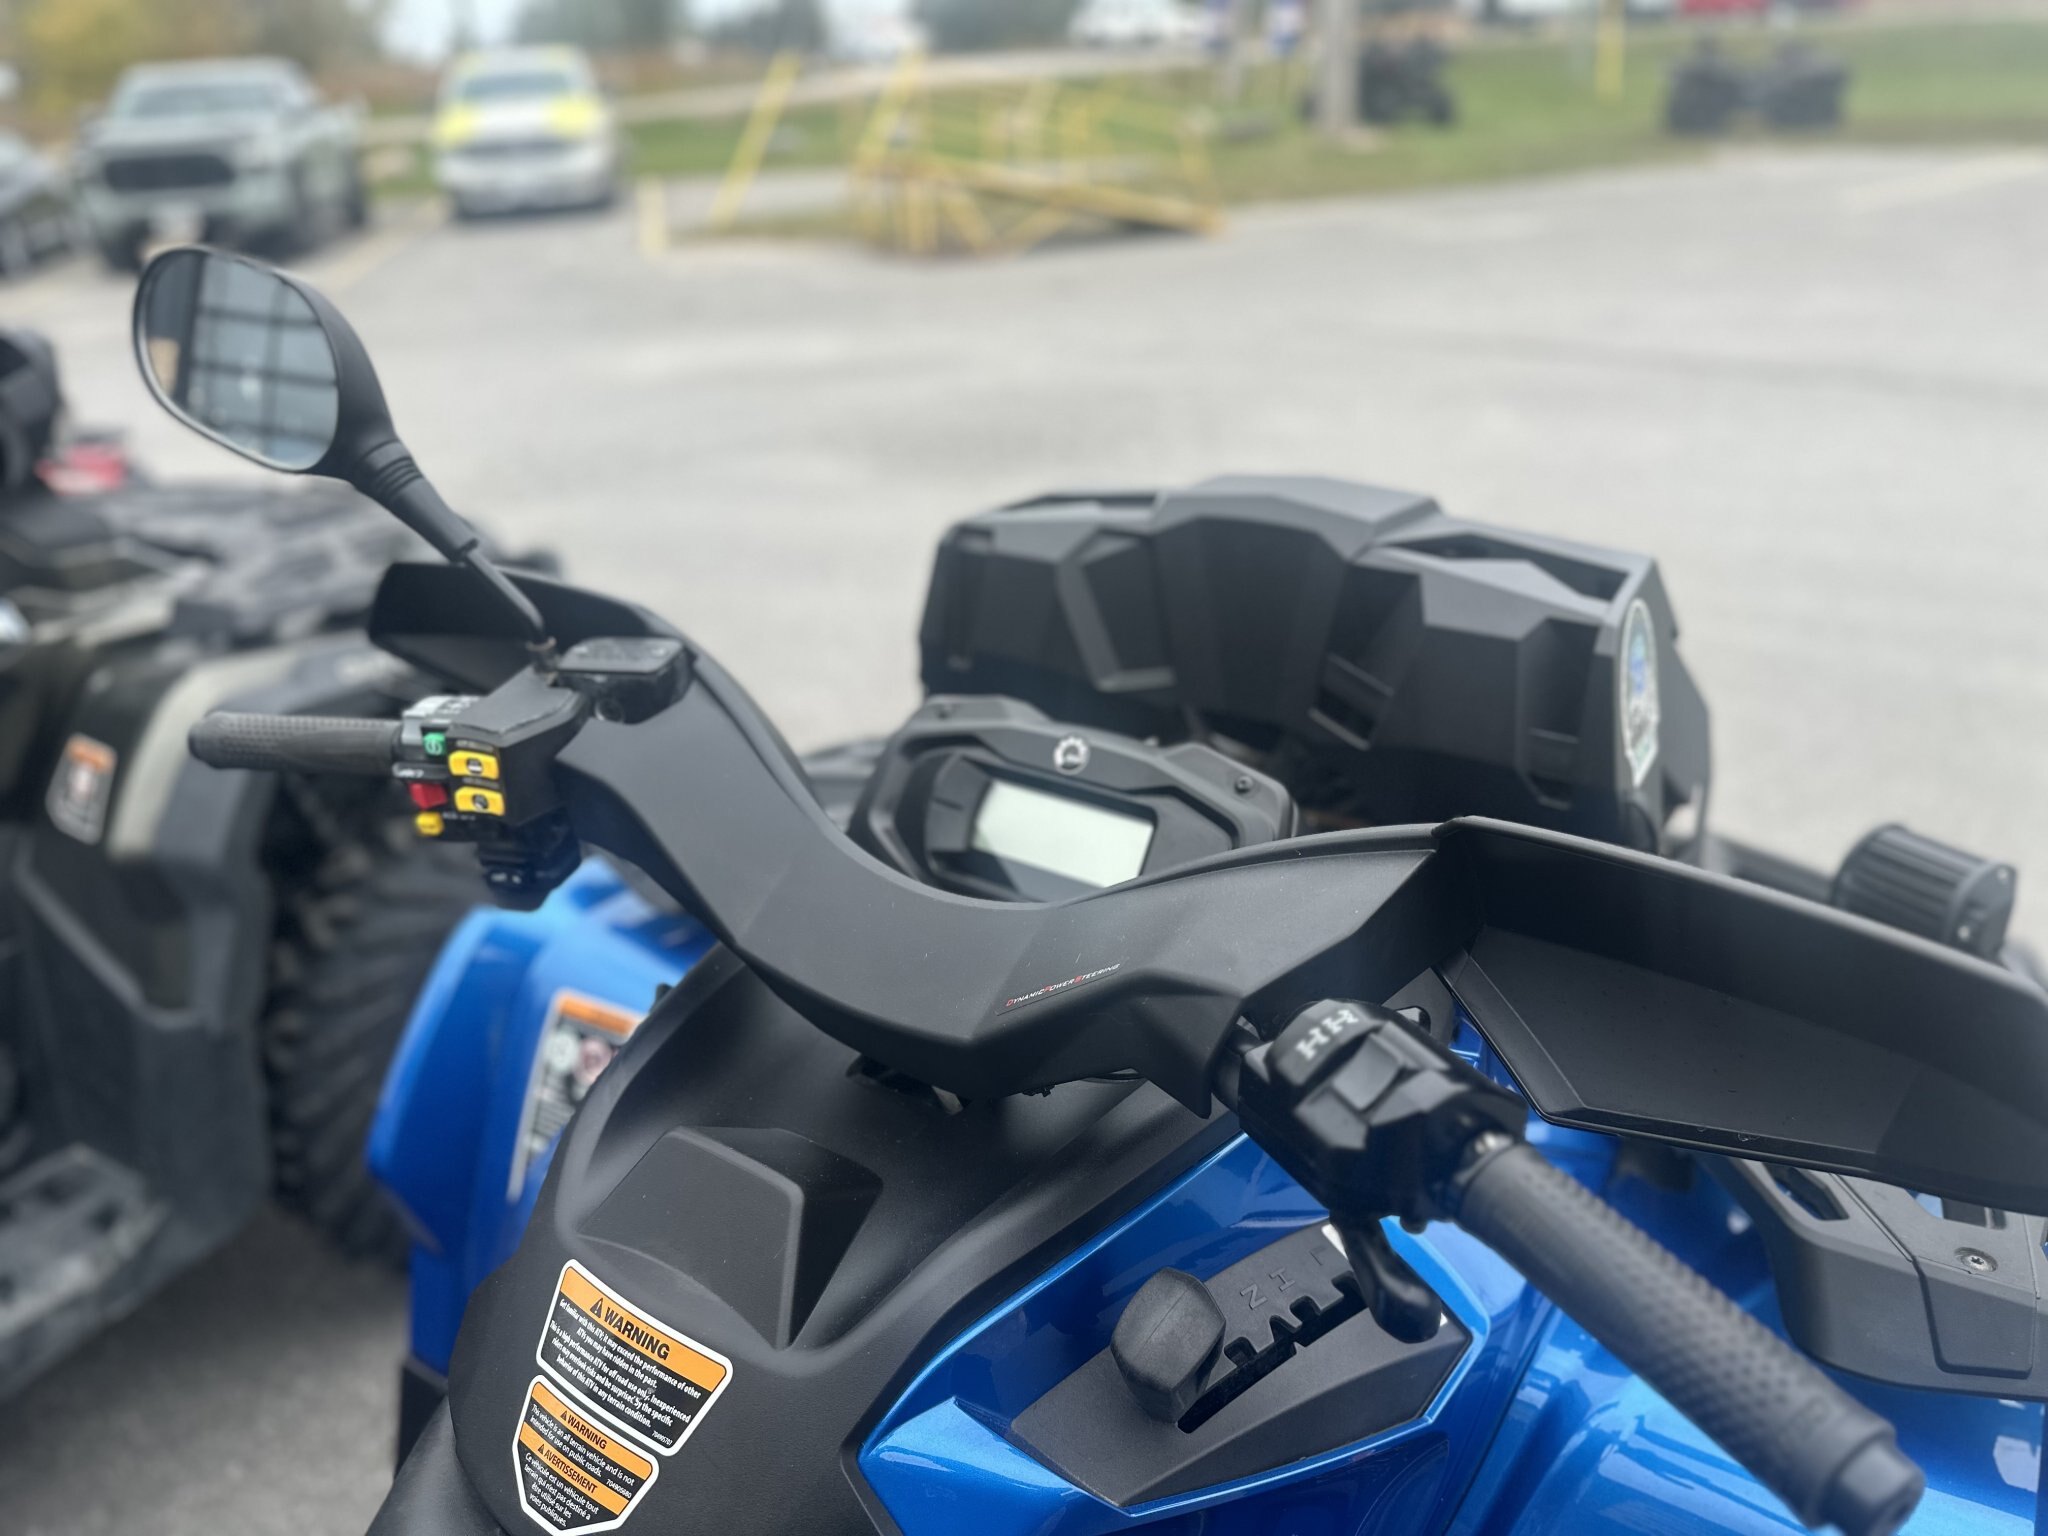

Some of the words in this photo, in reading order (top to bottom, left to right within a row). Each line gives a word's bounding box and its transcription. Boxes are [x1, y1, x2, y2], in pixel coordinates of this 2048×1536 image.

[565, 1303, 580, 1321] familiar
[578, 1315, 588, 1328] with
[587, 1321, 596, 1333] this
[603, 1333, 608, 1343] it
[607, 1338, 618, 1351] may
[617, 1345, 636, 1361] exceed
[634, 1355, 644, 1366] the
[642, 1361, 678, 1387] performance
[676, 1382, 686, 1390] of
[684, 1386, 702, 1399] other
[604, 1306, 670, 1360] WARNING
[550, 1320, 558, 1332] This
[556, 1326, 560, 1334] is
[562, 1330, 571, 1344] high
[568, 1340, 594, 1362] performance
[593, 1356, 604, 1368] ATV
[602, 1362, 610, 1374] for
[608, 1370, 618, 1378] off
[616, 1374, 630, 1386] road
[628, 1382, 638, 1392] use
[650, 1394, 692, 1424] Inexperienced
[552, 1336, 564, 1350] riders
[562, 1346, 570, 1358] may
[569, 1352, 587, 1370] overlook
[586, 1366, 596, 1378] risks
[595, 1373, 606, 1384] and
[604, 1378, 612, 1388] be
[642, 1402, 652, 1414] the
[650, 1410, 674, 1426] specific
[584, 1335, 594, 1346] you
[592, 1340, 604, 1354] may
[602, 1346, 614, 1360] have
[612, 1354, 630, 1370] ridden
[628, 1364, 635, 1374] in
[634, 1368, 644, 1380] the
[642, 1376, 658, 1388] past.
[572, 1368, 580, 1376] of
[576, 1372, 586, 1383] this
[584, 1377, 596, 1389] ATV
[592, 1383, 599, 1393] in
[598, 1388, 608, 1400] any
[606, 1394, 626, 1412] terrain
[624, 1406, 652, 1428] condition.
[532, 1404, 540, 1416] This
[539, 1412, 554, 1429] vehicle
[552, 1422, 558, 1432] is
[557, 1428, 564, 1436] an
[563, 1433, 571, 1442] all
[569, 1437, 586, 1455] terrain
[586, 1450, 606, 1468] vehicle
[604, 1463, 618, 1475] and
[616, 1468, 624, 1479] is
[622, 1475, 635, 1486] not
[554, 1436, 562, 1448] use
[562, 1444, 570, 1454] on
[568, 1448, 586, 1466] public
[584, 1458, 602, 1477] roads.
[568, 1414, 608, 1450] WARNING
[524, 1464, 538, 1480] terrain
[538, 1476, 546, 1487] qui
[556, 1492, 566, 1503] pas
[565, 1498, 586, 1518] destiné
[525, 1452, 532, 1462] Ce
[548, 1473, 558, 1482] est
[556, 1480, 564, 1489] un
[585, 1501, 600, 1515] tout
[544, 1450, 598, 1494] AVERTISSEMENT
[529, 1493, 542, 1507] voies
[540, 1504, 566, 1527] publiques.
[554, 1502, 564, 1512] sur
[562, 1508, 572, 1518] les
